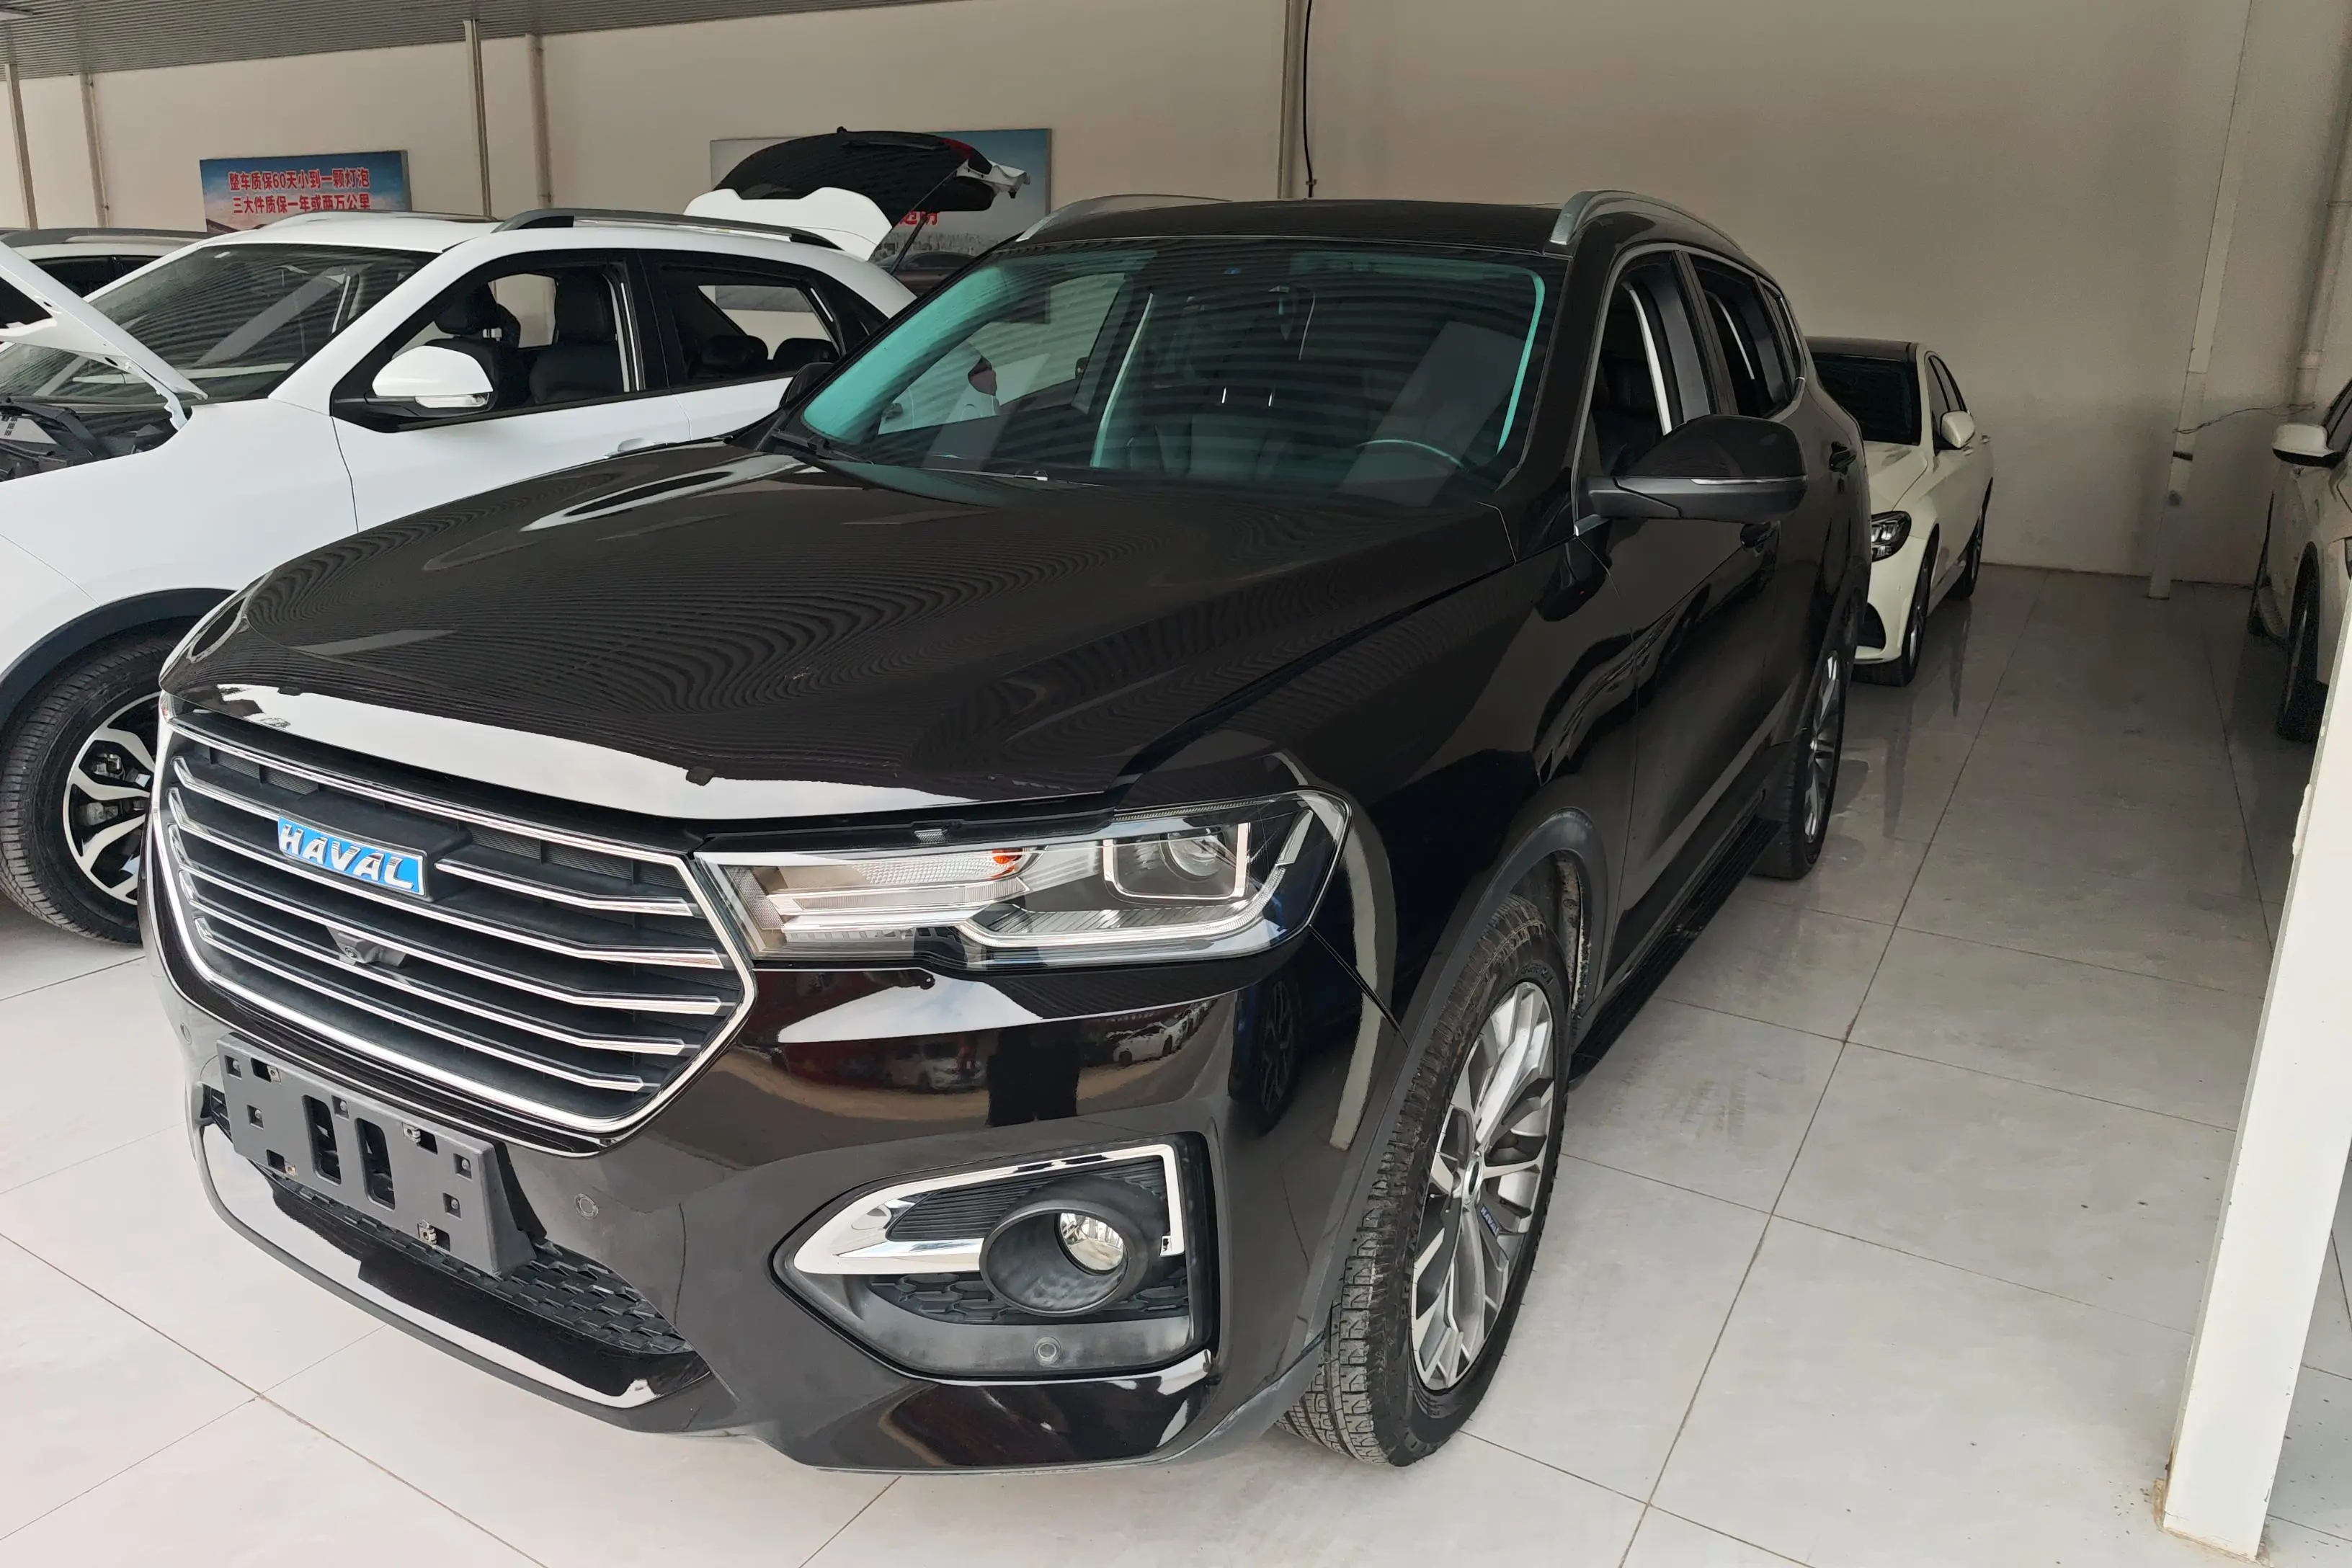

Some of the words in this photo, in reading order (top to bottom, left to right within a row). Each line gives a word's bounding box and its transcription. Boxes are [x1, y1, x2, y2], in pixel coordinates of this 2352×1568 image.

[228, 169, 370, 191] 整车质保60天小到一颗灯泡
[232, 194, 371, 214] 三大件质保一年或两万公里
[279, 823, 414, 890] HAVAL
[1480, 1205, 1500, 1238] HAVAL
